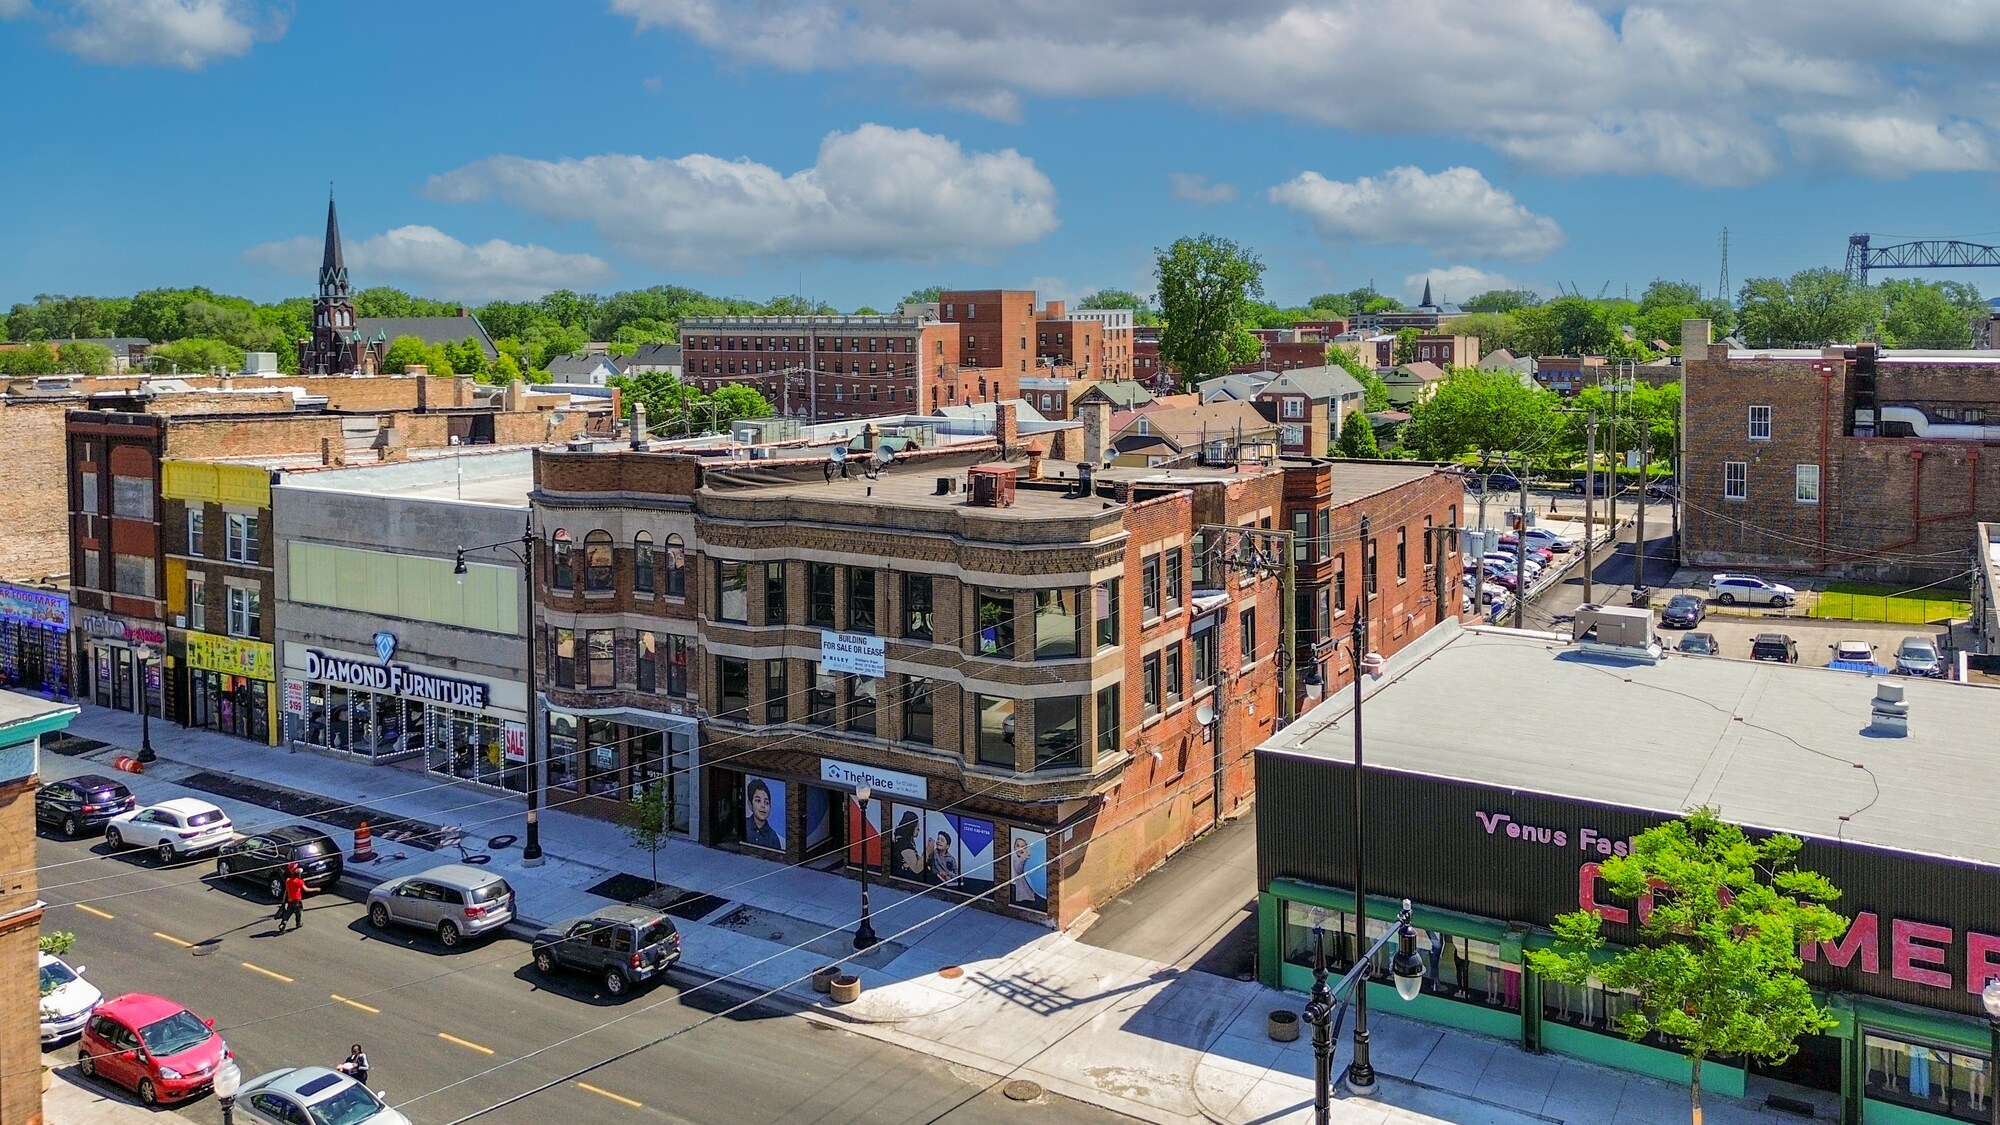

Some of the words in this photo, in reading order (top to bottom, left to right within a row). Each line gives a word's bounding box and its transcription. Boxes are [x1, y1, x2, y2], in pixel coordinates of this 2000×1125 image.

[12, 591, 33, 602] FOOD
[35, 595, 62, 608] MART
[82, 615, 126, 637] metro
[823, 641, 836, 650] FOR
[836, 643, 852, 652] SALE
[853, 645, 862, 653] OR
[863, 647, 883, 657] LEASE
[838, 634, 867, 645] BUILDING
[306, 652, 388, 689] DIAMOND
[390, 667, 484, 708] FURNITURE
[506, 729, 525, 757] SALE
[843, 769, 862, 782] The
[865, 774, 894, 789] Place
[1475, 810, 1567, 848] Venus
[1578, 862, 2000, 996] CME
